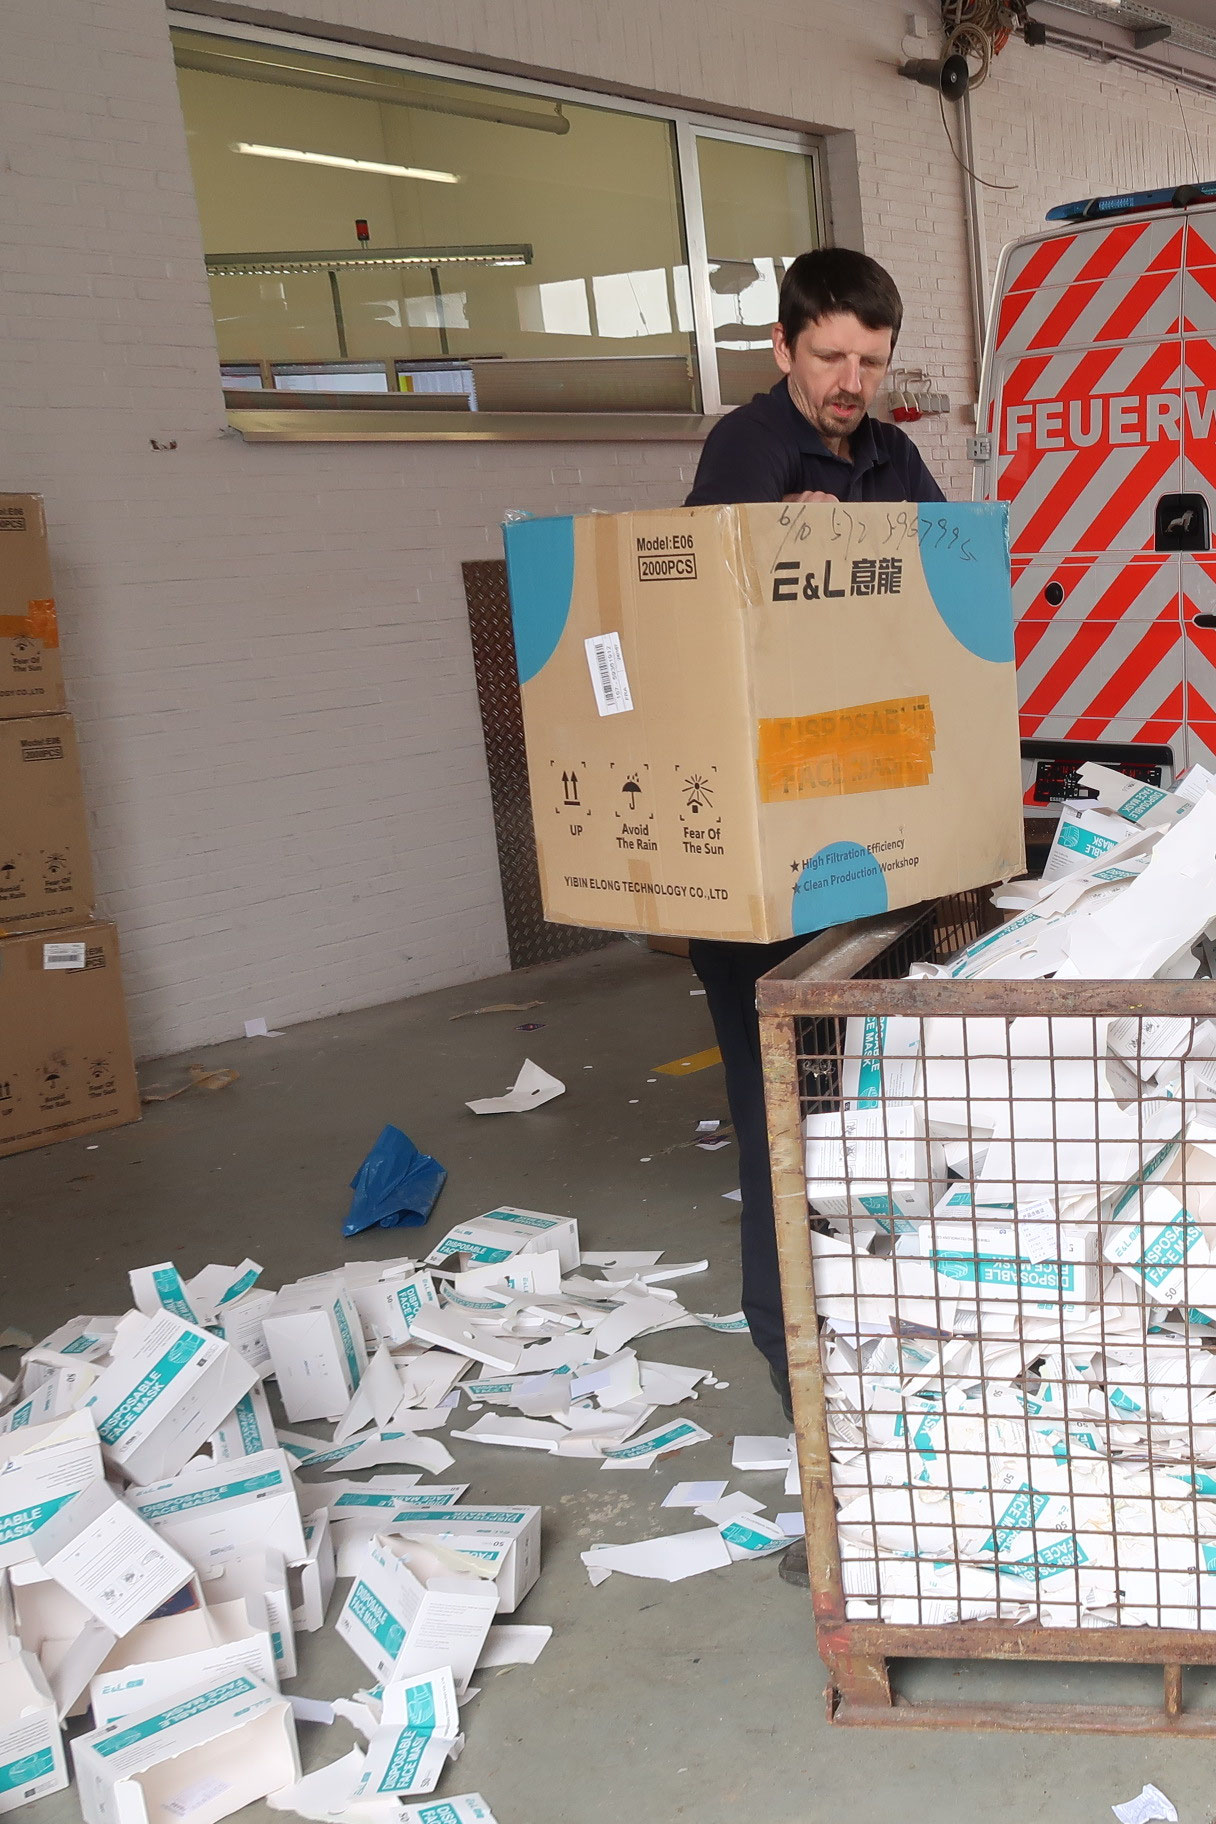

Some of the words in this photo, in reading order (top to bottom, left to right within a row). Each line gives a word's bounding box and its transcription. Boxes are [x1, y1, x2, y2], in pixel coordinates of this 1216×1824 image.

[636, 534, 694, 552] Model:E06
[641, 558, 694, 576] 2000PCS
[849, 556, 903, 598] 意龍
[771, 558, 847, 602] E&L
[569, 824, 583, 836] UP
[621, 823, 649, 836] Avoid
[683, 826, 705, 839] Fear
[708, 827, 721, 840] Of
[616, 837, 634, 850] The
[637, 838, 658, 851] Rain
[683, 841, 702, 854] The
[704, 843, 724, 855] Sun
[802, 855, 824, 871] High
[826, 847, 866, 865] Filtration
[867, 838, 905, 855] Efficiency
[803, 877, 829, 892] Clean
[830, 864, 878, 885] Production
[878, 855, 920, 874] Workshop
[564, 875, 588, 888] YIBIN
[590, 878, 621, 892] ELONG
[622, 881, 687, 898] TECHNOLOGY
[689, 886, 729, 900] CO.,LTD
[444, 1239, 488, 1255] DISPOSABLE
[984, 1267, 1070, 1288] DISPOSABLE
[1164, 1287, 1178, 1301] 50
[99, 1370, 163, 1437] DISPOSABLE
[133, 1382, 166, 1415] MASK
[143, 1485, 229, 1513] DISPOSABLE
